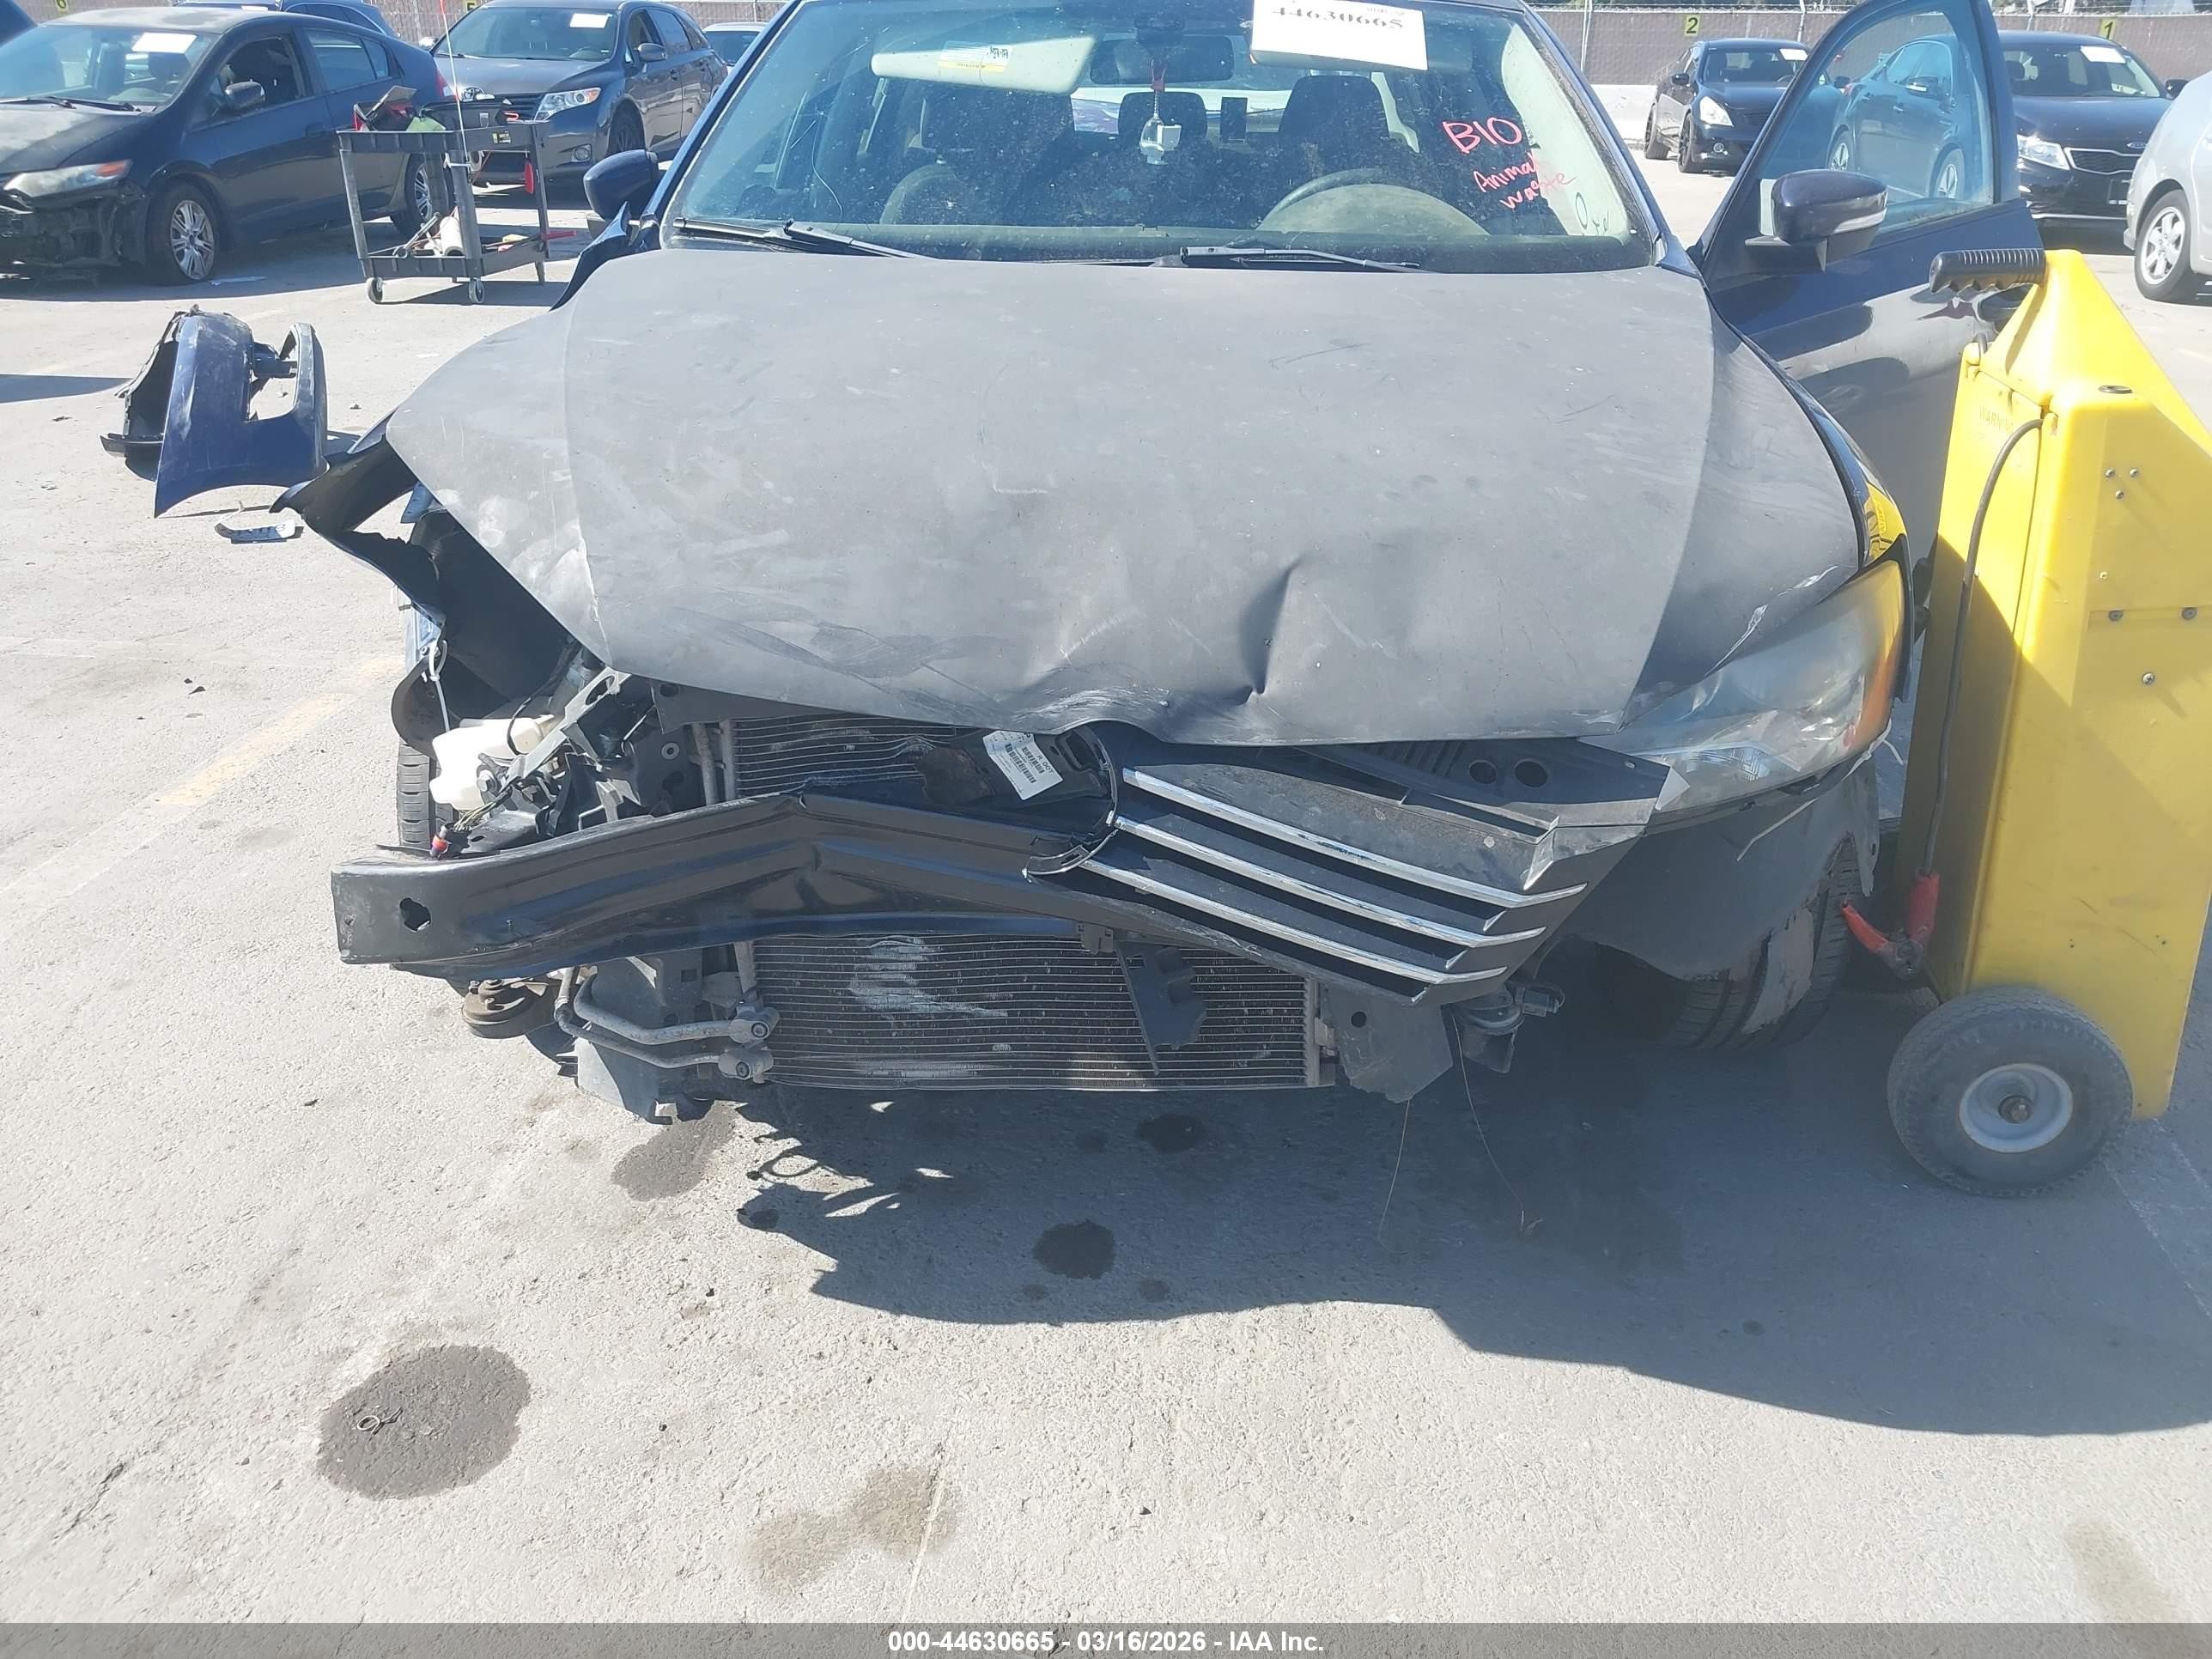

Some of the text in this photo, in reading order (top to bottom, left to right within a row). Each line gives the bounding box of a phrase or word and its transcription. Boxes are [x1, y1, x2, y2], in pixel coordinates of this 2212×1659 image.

[1686, 16, 1698, 34] 2
[2104, 21, 2113, 40] 1
[1442, 116, 1523, 155] BIO
